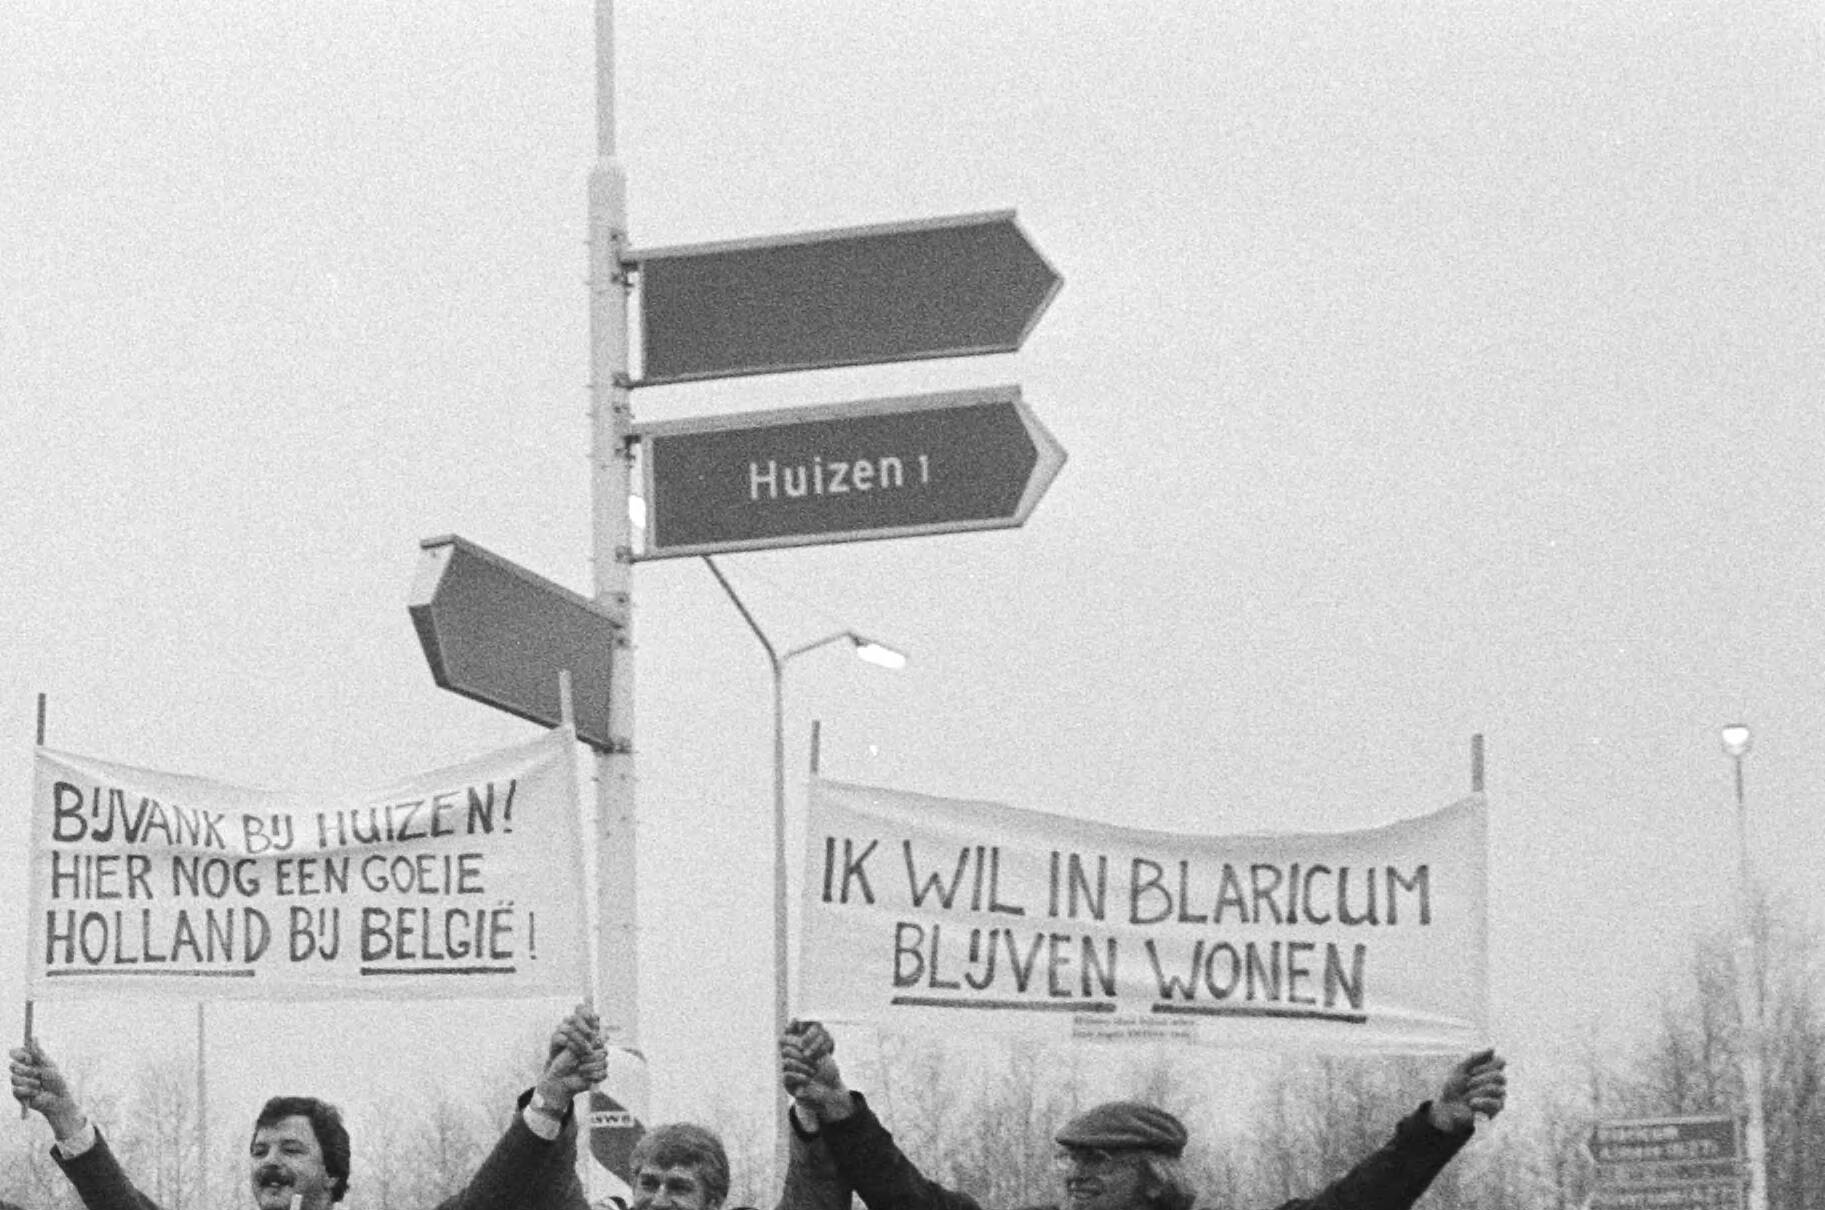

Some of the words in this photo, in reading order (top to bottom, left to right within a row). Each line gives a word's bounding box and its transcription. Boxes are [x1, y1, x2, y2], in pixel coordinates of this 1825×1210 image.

[749, 456, 903, 500] Huizen
[919, 454, 929, 483] 1
[52, 780, 225, 850] BIJVANK
[243, 813, 294, 854] BIJ
[317, 779, 518, 847] HUIZEN!
[50, 850, 153, 900] HIER
[172, 854, 262, 899] NOG
[274, 855, 350, 896] EEN
[360, 852, 485, 895] GOEIE
[821, 836, 879, 906] IK
[902, 838, 1025, 917] WIL
[1048, 850, 1107, 921] IN
[1129, 855, 1432, 927] BLARICUM
[45, 907, 271, 965] HOLLAND
[288, 905, 340, 963] BIJ
[891, 922, 1118, 998] BLIJVEN
[1145, 938, 1367, 1010] WONEN
